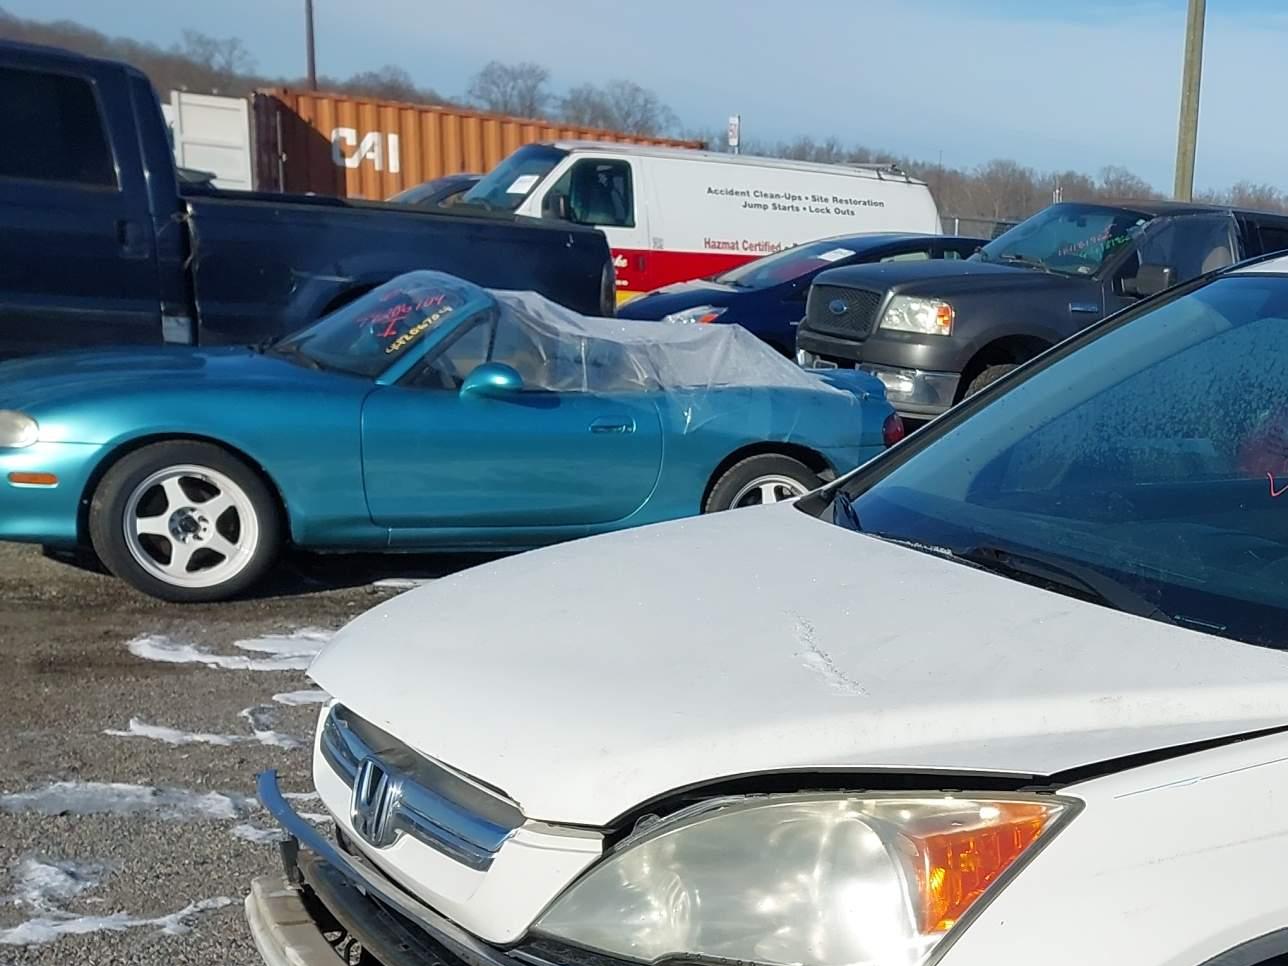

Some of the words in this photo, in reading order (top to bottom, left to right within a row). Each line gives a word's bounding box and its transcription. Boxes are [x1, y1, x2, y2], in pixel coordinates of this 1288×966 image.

[331, 127, 399, 173] CAI
[706, 187, 750, 198] Accident
[753, 190, 802, 202] Clean-Ups
[811, 195, 829, 204] Site
[832, 196, 885, 208] Restoration
[742, 201, 769, 211] Jump
[771, 203, 800, 213] Starts
[809, 206, 831, 215] Lock
[834, 207, 856, 216] Outs
[703, 238, 740, 250] Hazmat
[742, 240, 781, 252] Certified
